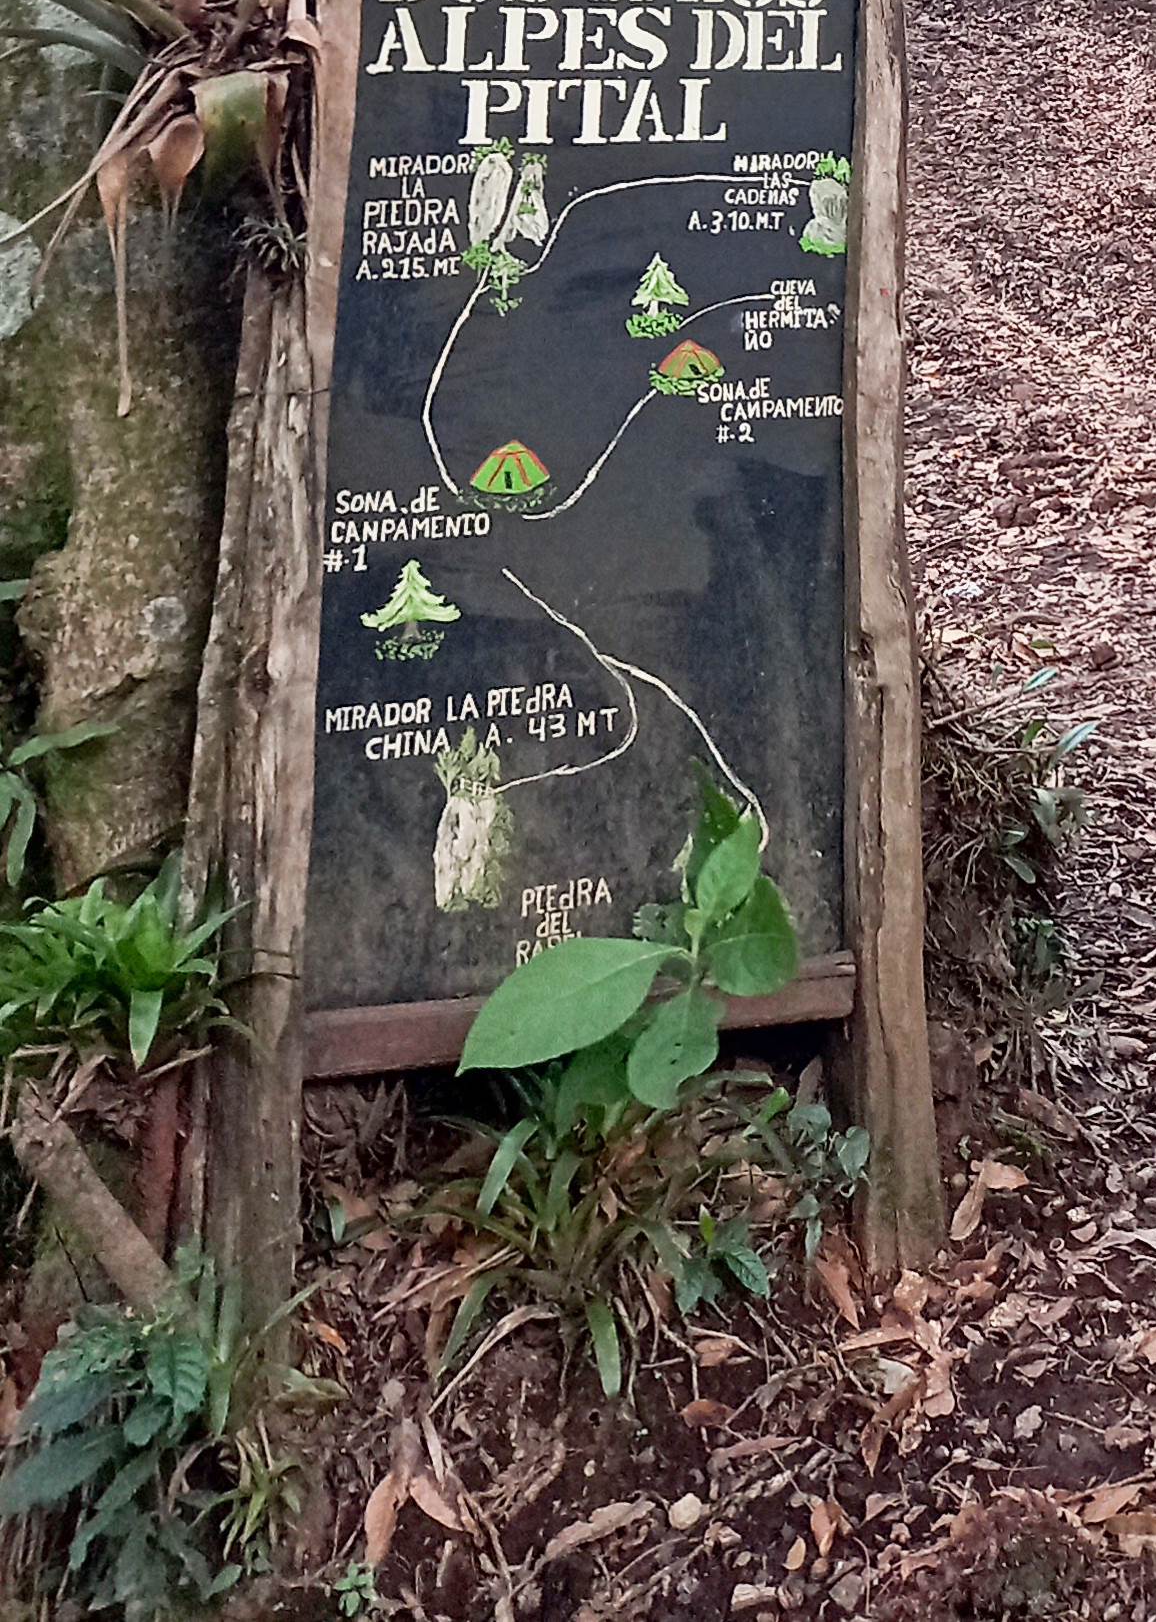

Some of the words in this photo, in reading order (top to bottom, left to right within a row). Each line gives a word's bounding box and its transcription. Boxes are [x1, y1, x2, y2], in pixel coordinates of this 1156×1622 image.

[365, 6, 672, 75] ALPES
[690, 8, 842, 72] DEL
[458, 78, 727, 146] PITAL
[368, 154, 471, 178] MIRADOR
[733, 151, 820, 172] MIRADOR
[401, 176, 425, 198] LA
[763, 172, 792, 190] LAS
[724, 188, 800, 206] CADENAS
[363, 198, 460, 229] PIEDRA
[770, 279, 817, 296] CUEVA
[331, 512, 490, 544] CANPAMENTO
[325, 697, 432, 733] MIRADOR
[446, 692, 480, 722] LA
[365, 727, 450, 761] CHINA
[527, 714, 567, 743] 43
